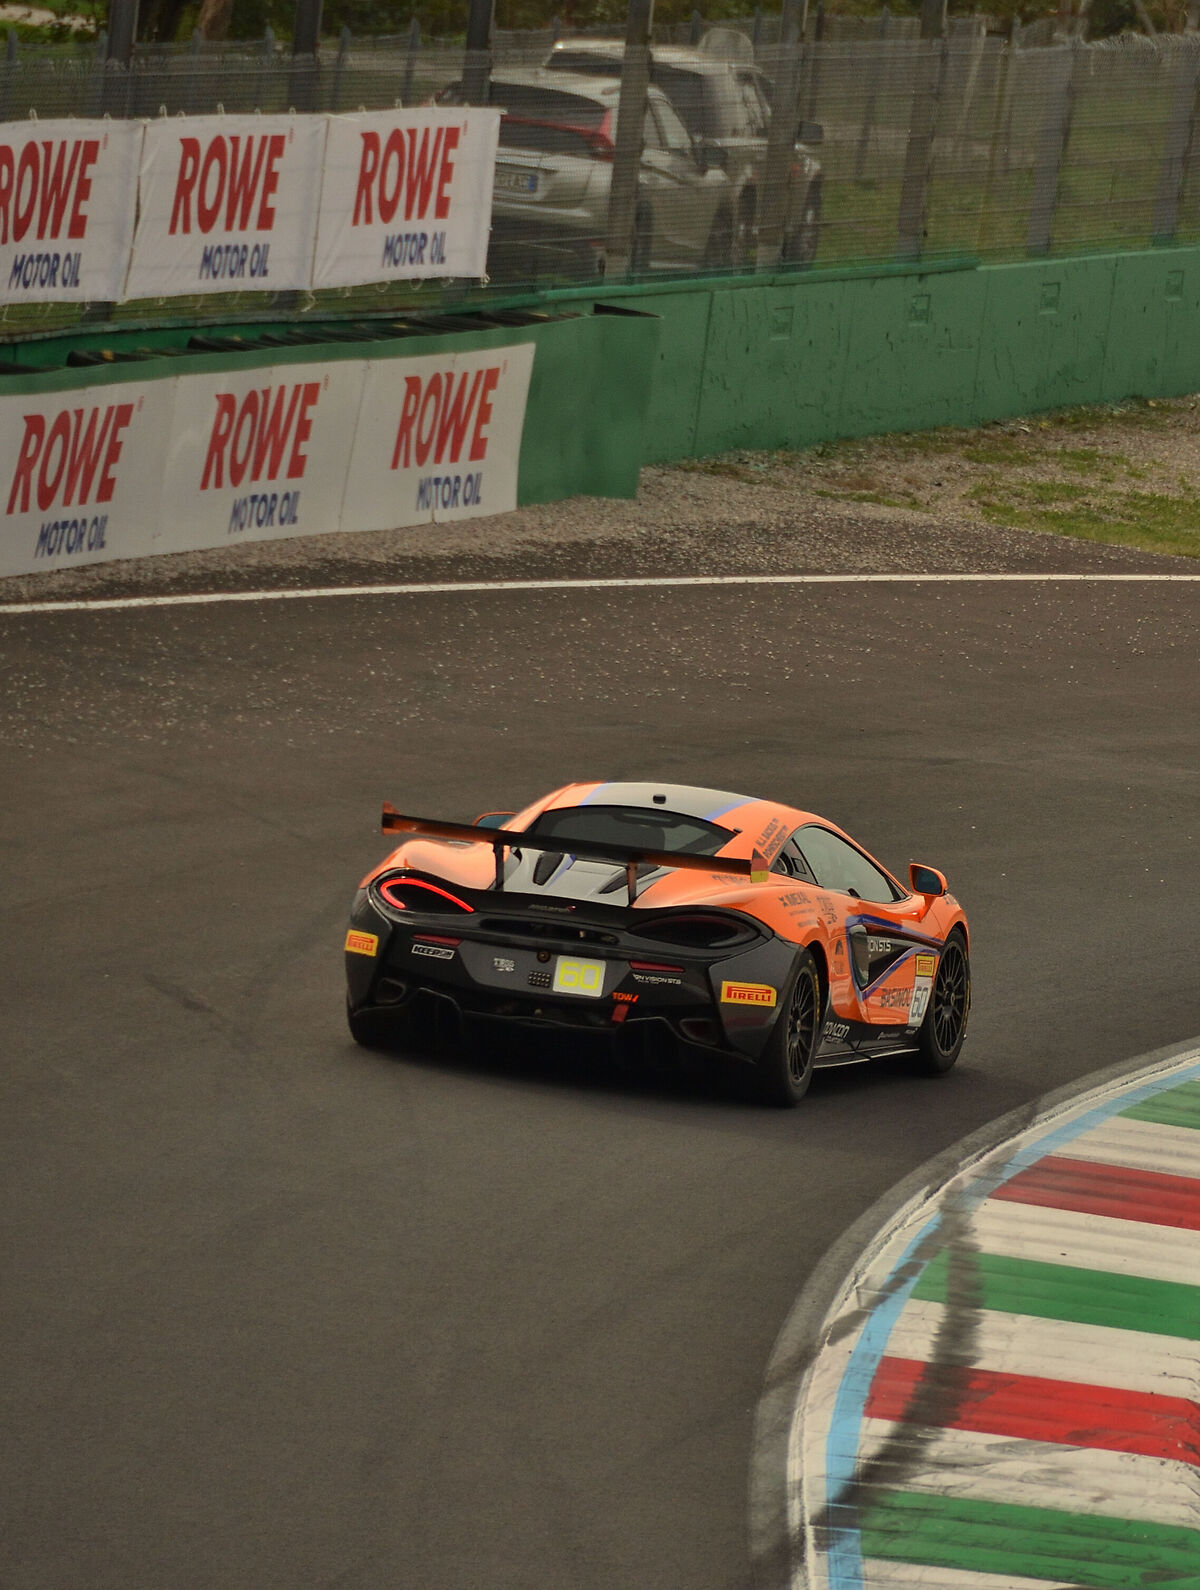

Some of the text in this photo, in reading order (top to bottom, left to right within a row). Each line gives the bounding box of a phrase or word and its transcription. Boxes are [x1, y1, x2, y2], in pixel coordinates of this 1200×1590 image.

[0, 140, 100, 244] ROWE
[168, 134, 285, 235] ROWE
[352, 126, 461, 226] ROWE
[199, 243, 270, 279] MOTOR OIL
[382, 231, 446, 268] MOTOR OIL
[9, 252, 82, 290] MOTOR OIL
[200, 382, 320, 490] ROWE
[390, 368, 500, 470] ROWE
[6, 404, 134, 515] ROWE
[415, 472, 482, 511] MOTOR OIL
[228, 491, 300, 534] MOTOR OIL
[34, 515, 108, 558] MOTOR OIL
[559, 961, 600, 990] 60
[726, 985, 772, 1002] PIRELLI
[611, 992, 633, 1002] TOW
[911, 985, 929, 1018] 60
